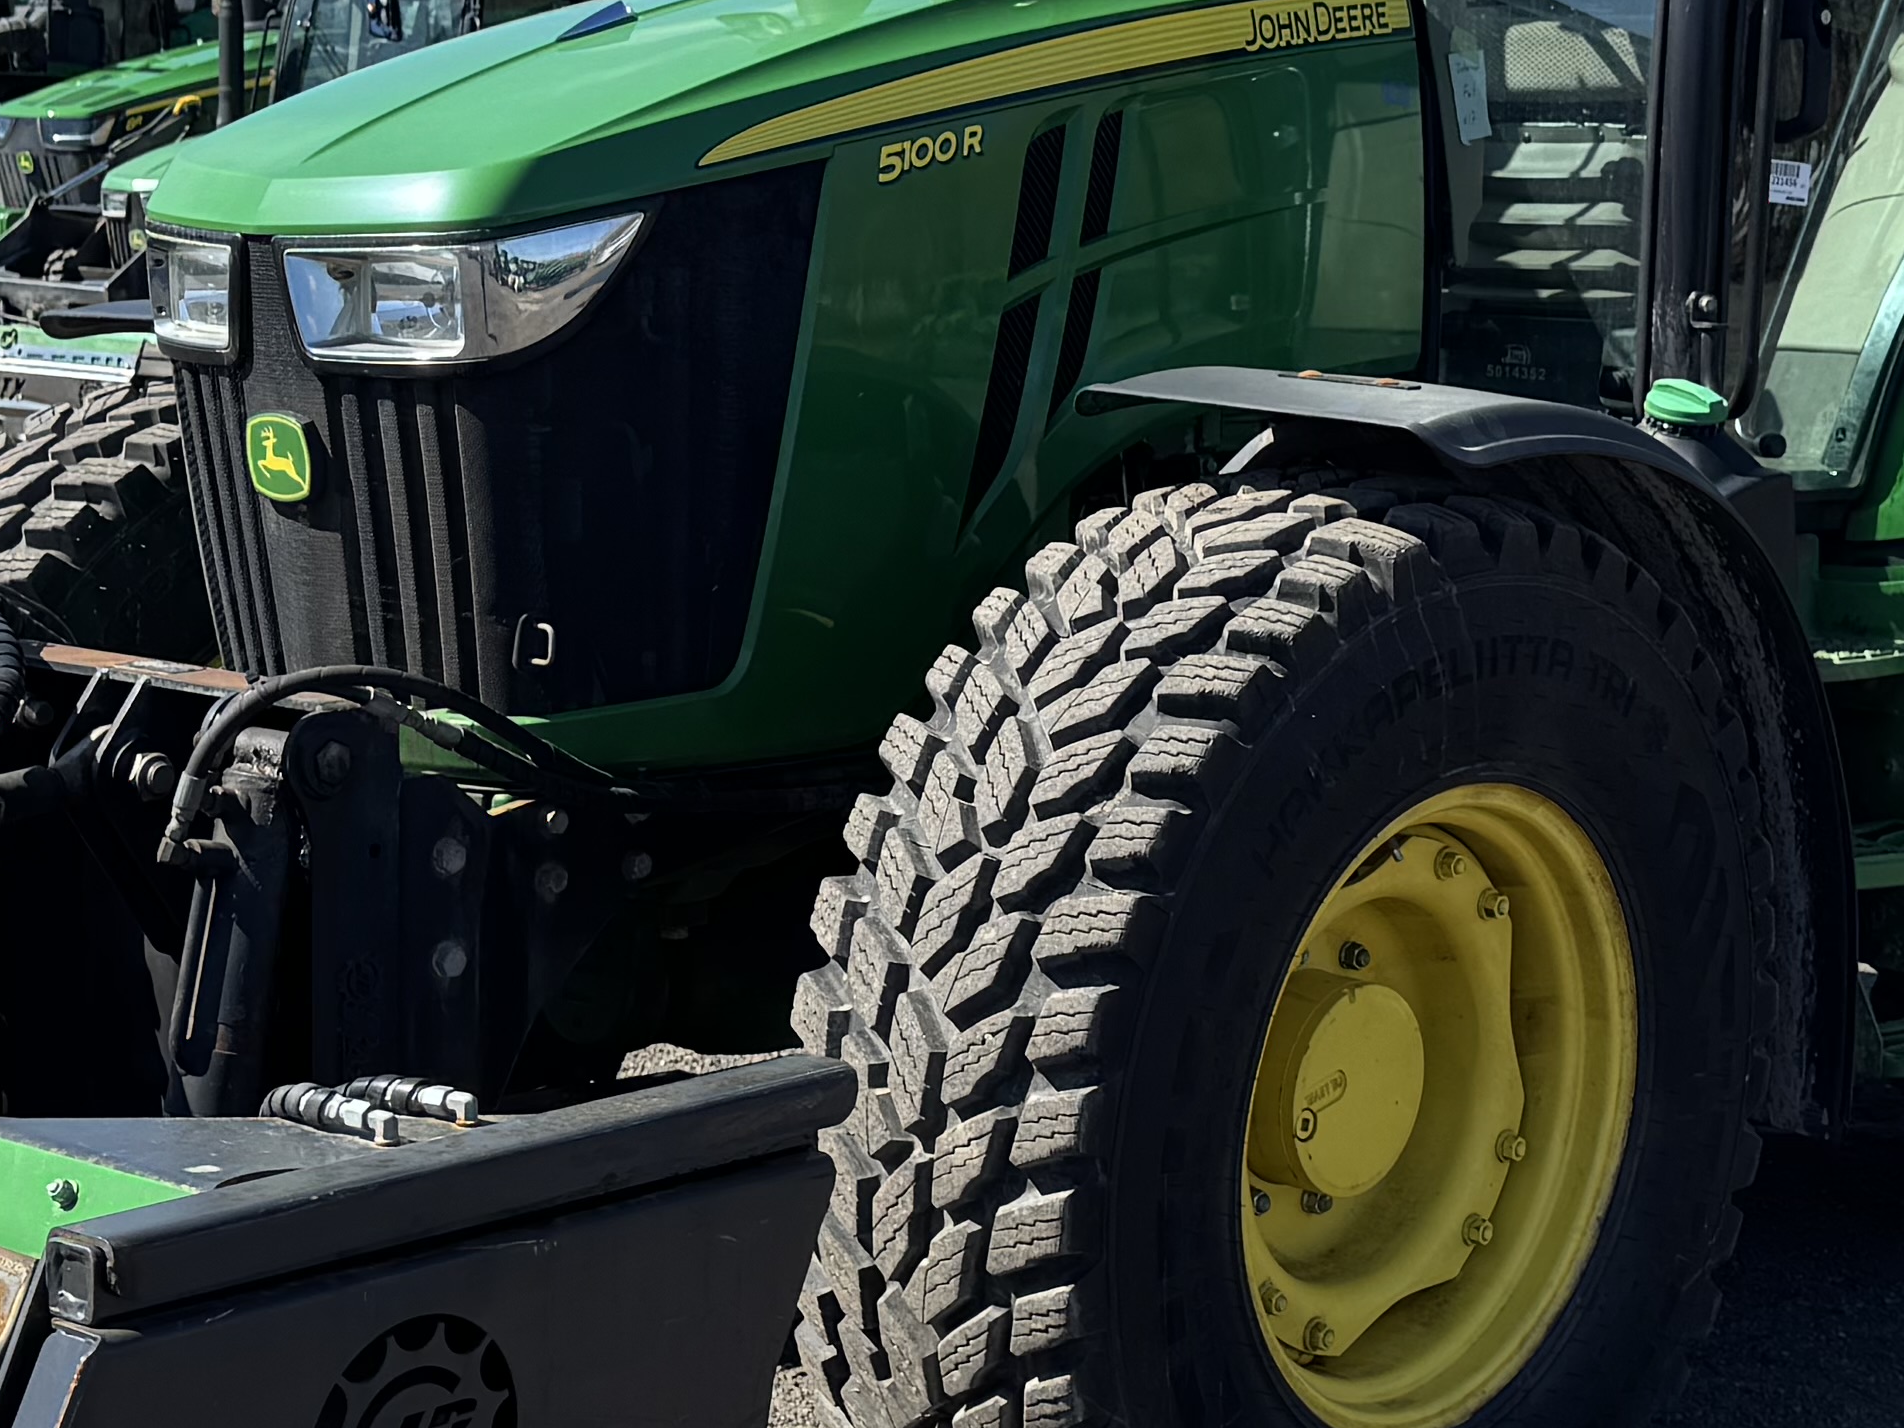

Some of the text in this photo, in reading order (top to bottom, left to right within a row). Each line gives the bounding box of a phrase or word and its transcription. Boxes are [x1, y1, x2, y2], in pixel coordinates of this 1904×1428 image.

[1245, 2, 1390, 48] JOHN DEERE
[878, 125, 983, 183] 5100 R
